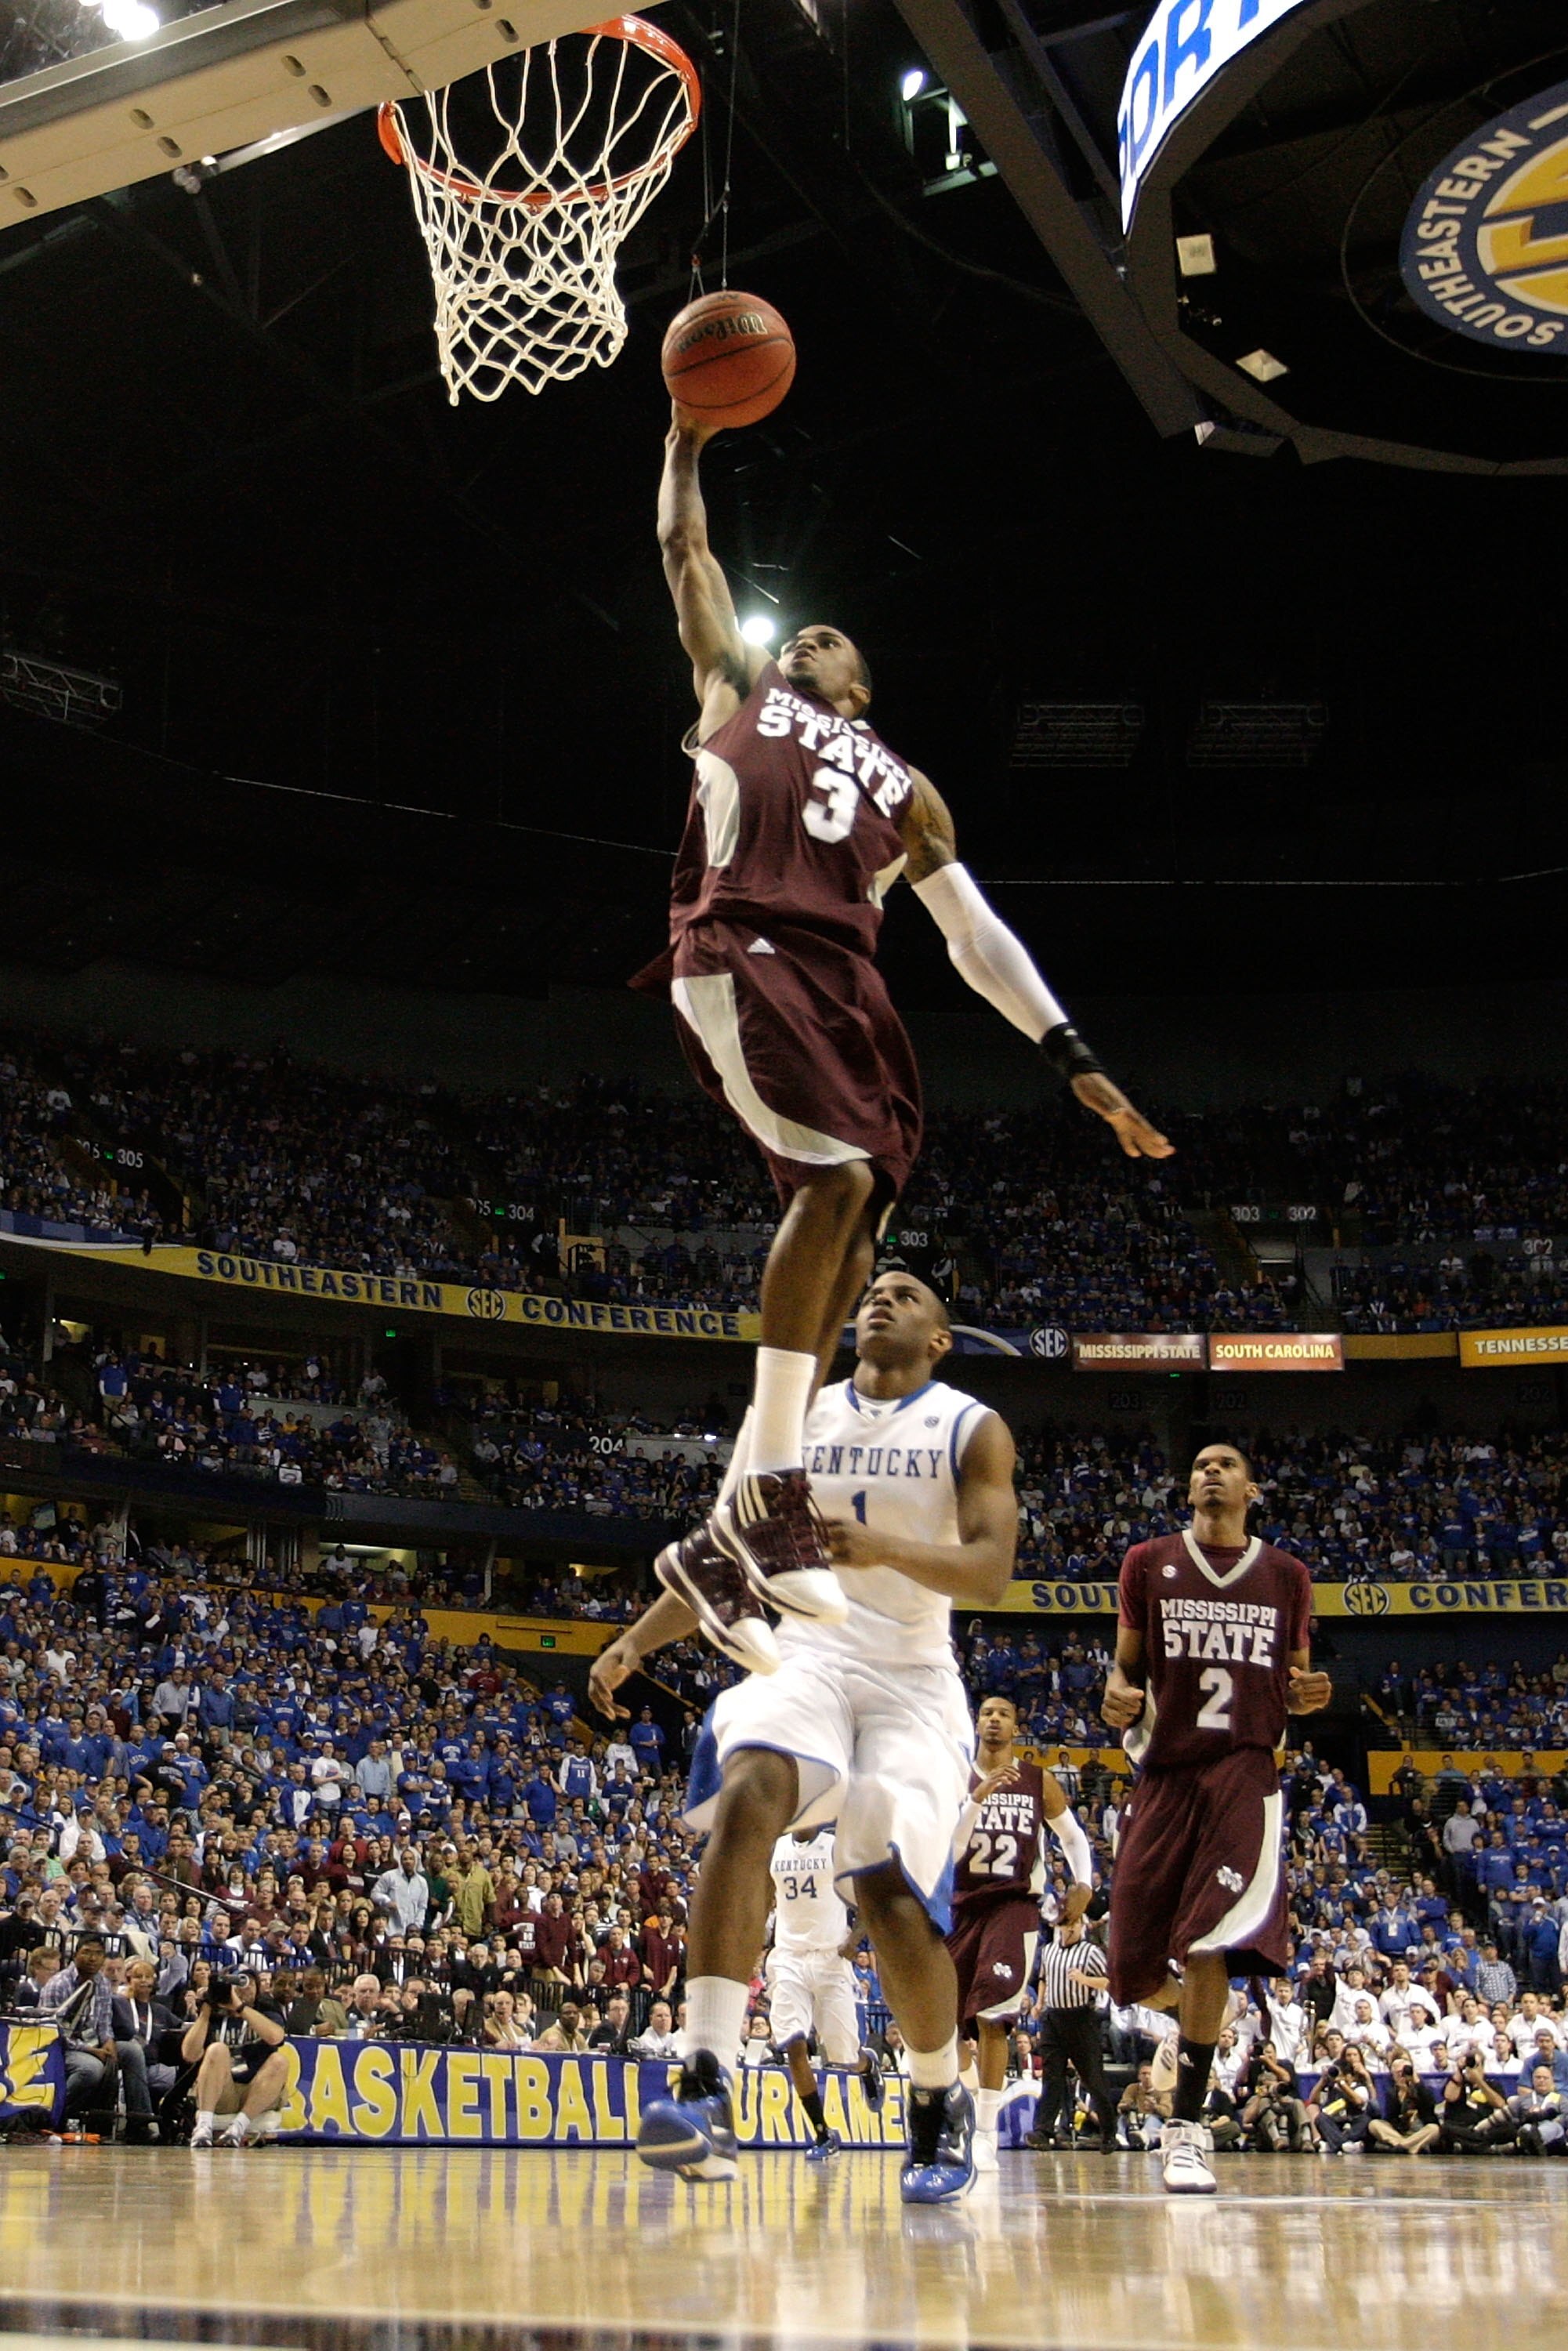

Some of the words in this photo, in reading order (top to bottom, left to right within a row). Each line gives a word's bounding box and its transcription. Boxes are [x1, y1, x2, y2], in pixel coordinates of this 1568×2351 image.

[1416, 128, 1565, 346] SOUTHEASTERN
[677, 312, 769, 354] Wilson
[801, 765, 860, 845] 3
[117, 1148, 143, 1168] 305
[508, 1203, 534, 1222] 304
[1288, 1205, 1316, 1222] 302
[900, 1230, 928, 1248] 303
[197, 1252, 442, 1308] SOUTHEASTERN
[471, 1289, 502, 1320] SEC
[522, 1296, 741, 1337] CONFERENCE
[1034, 1328, 1066, 1358] SEC
[1079, 1344, 1159, 1359] MISSISSIPPI
[1161, 1344, 1200, 1360] STATE
[1215, 1343, 1262, 1360] SOUTH
[1265, 1343, 1334, 1359] CAROLINA
[589, 1436, 624, 1454] 204
[851, 1490, 867, 1527] 1
[1159, 1598, 1277, 1628] MISSISSIPPI
[1345, 1583, 1387, 1614] SEC
[1163, 1618, 1274, 1668] STATE
[1196, 1667, 1233, 1730] 2
[974, 1806, 1034, 1835] TATE
[773, 1857, 827, 1872] KENTUCKY
[969, 1831, 1018, 1877] 22
[784, 1875, 818, 1900] 34
